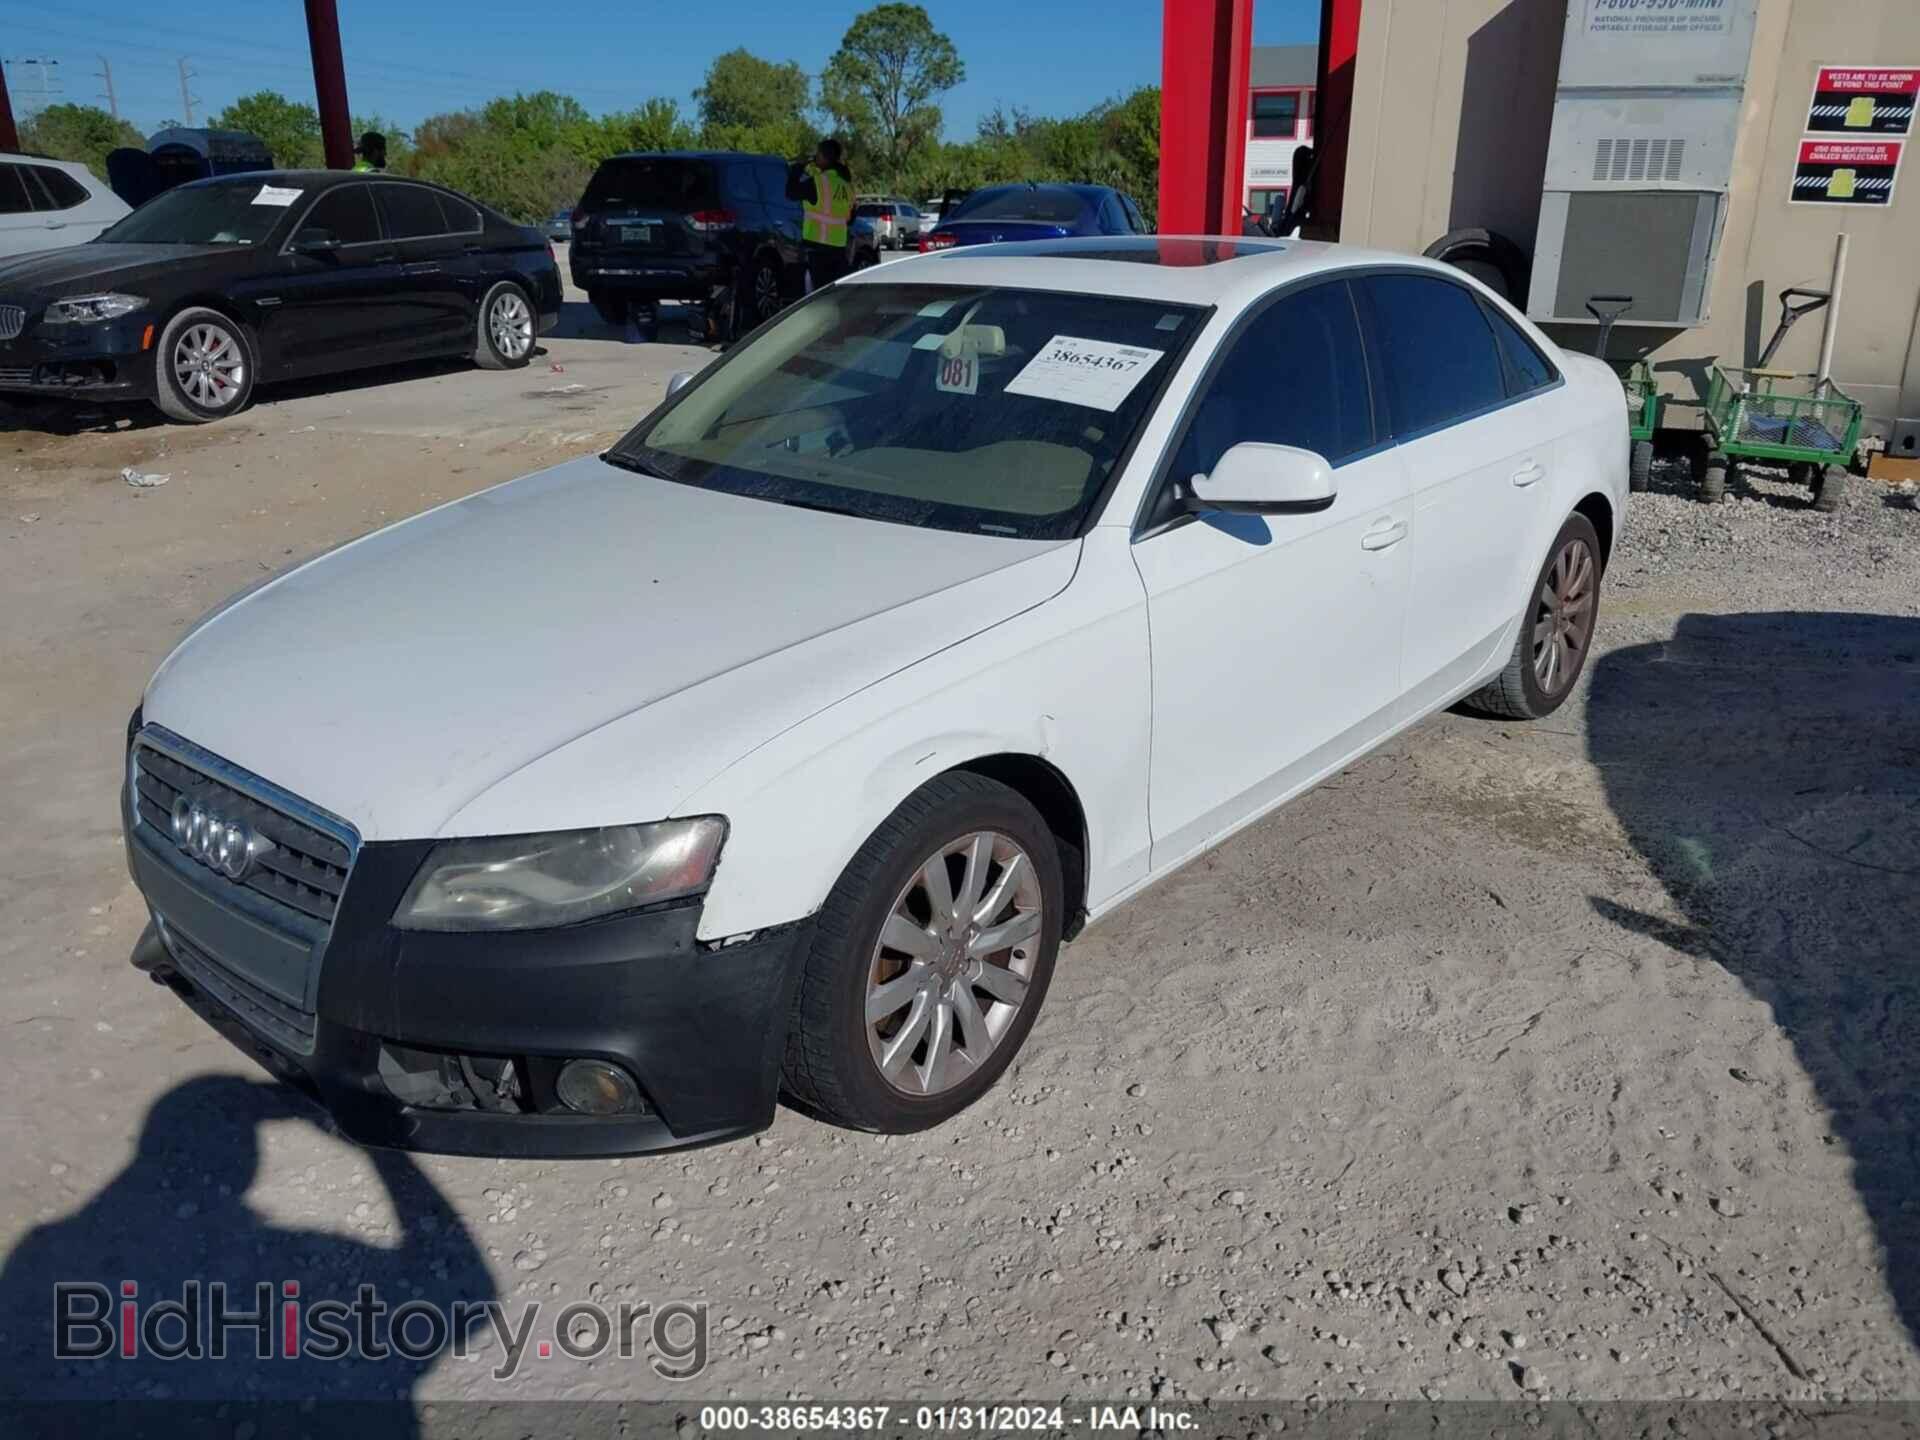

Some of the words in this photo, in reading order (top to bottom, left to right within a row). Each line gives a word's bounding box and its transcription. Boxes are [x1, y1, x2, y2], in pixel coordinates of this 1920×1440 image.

[1828, 72, 1851, 80] VESTS
[1047, 349, 1138, 372] 38654367
[942, 359, 972, 387] 081
